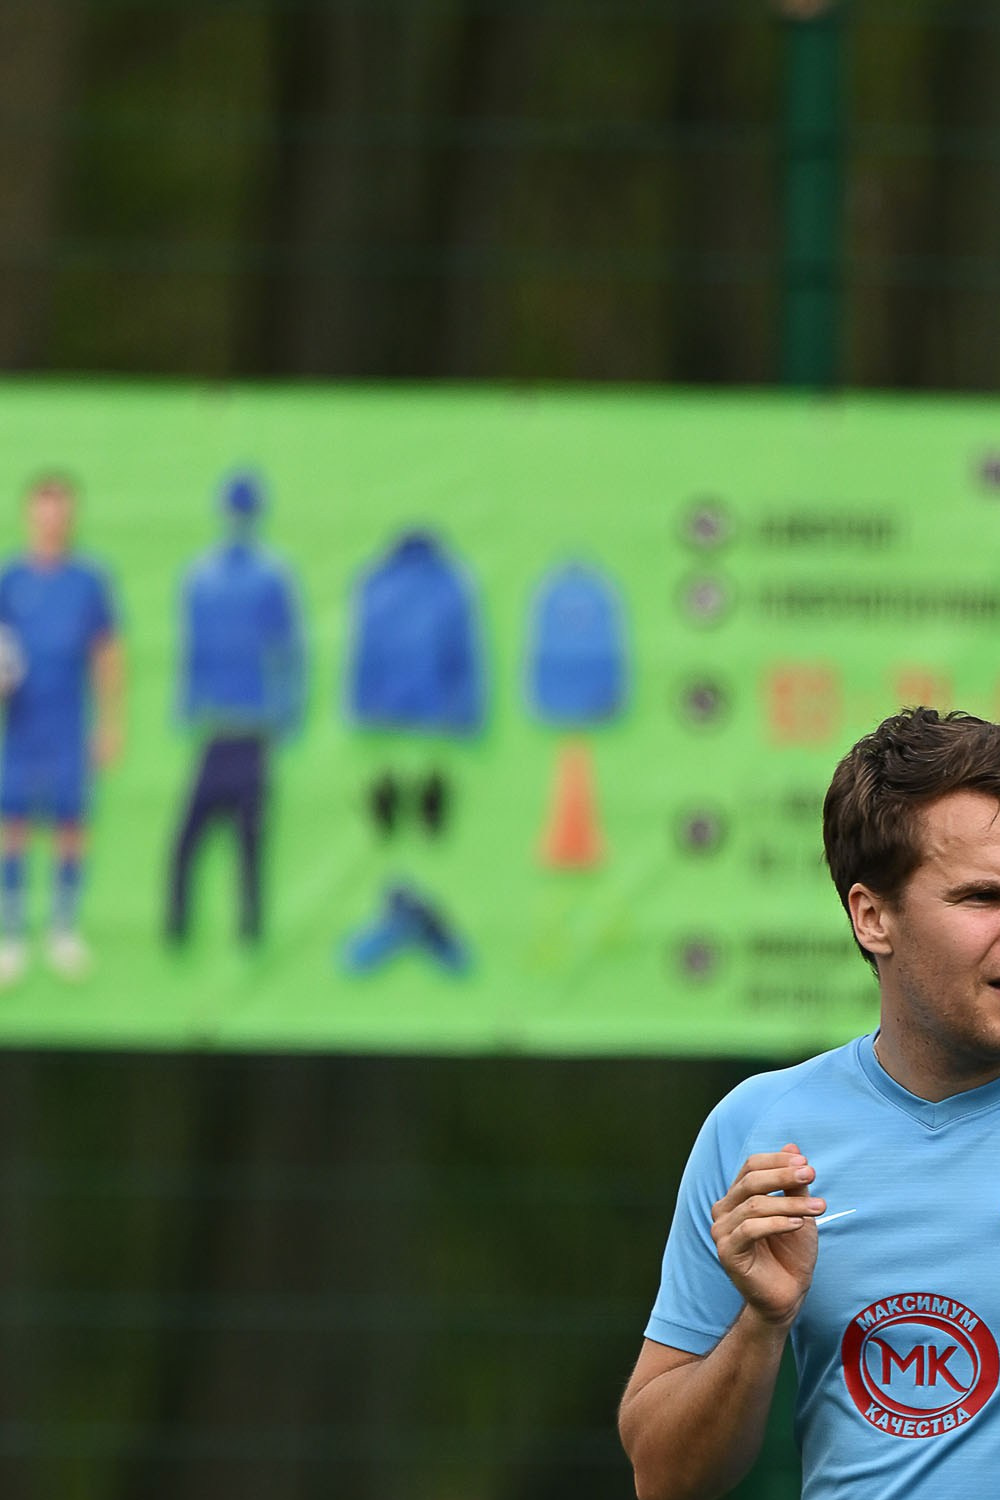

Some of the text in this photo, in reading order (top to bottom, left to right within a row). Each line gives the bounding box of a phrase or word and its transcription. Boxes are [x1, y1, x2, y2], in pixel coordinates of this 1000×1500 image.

[855, 1295, 979, 1332] МАКСИМУМ
[868, 1337, 969, 1393] МК
[864, 1402, 971, 1436] КАЧЕСТВА
